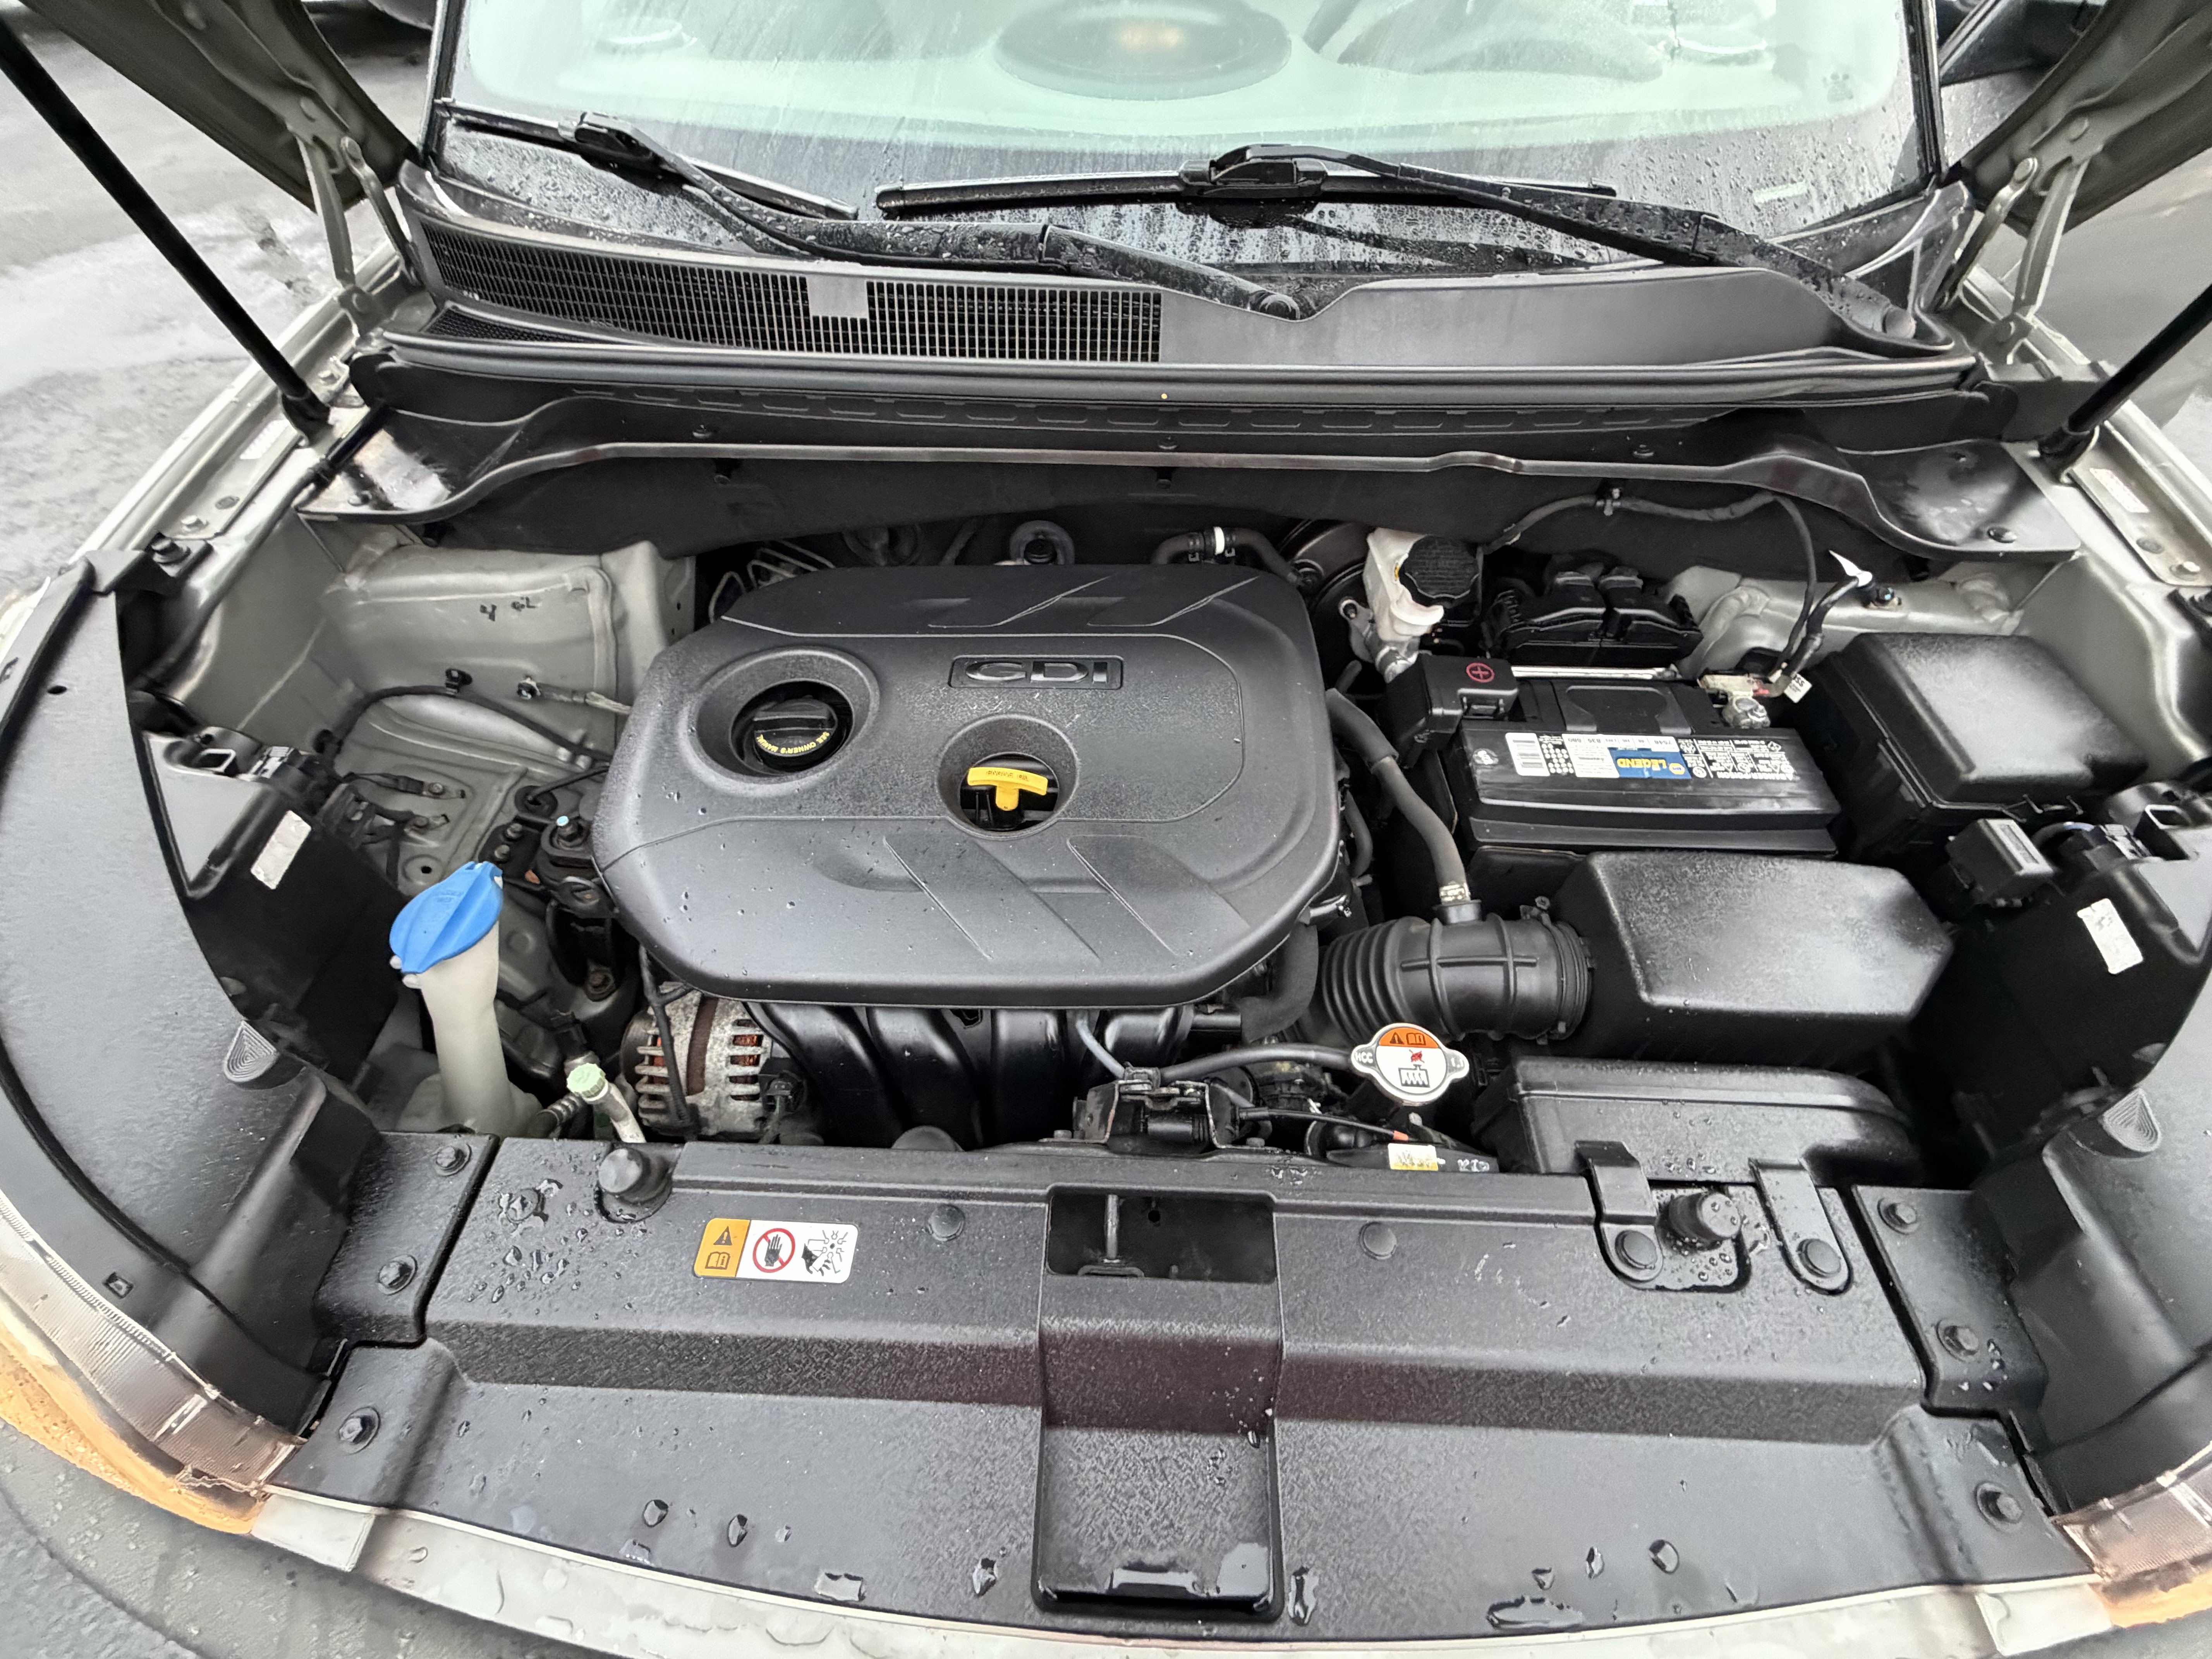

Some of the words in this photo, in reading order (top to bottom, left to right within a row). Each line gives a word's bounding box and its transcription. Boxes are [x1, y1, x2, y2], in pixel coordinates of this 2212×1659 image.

[965, 661, 1108, 684] GDI
[756, 734, 779, 753] MANUAL
[816, 732, 830, 744] SEE
[780, 741, 817, 754] OWNER'S
[1616, 757, 1667, 769] LEGEND
[1355, 1051, 1373, 1063] HCC
